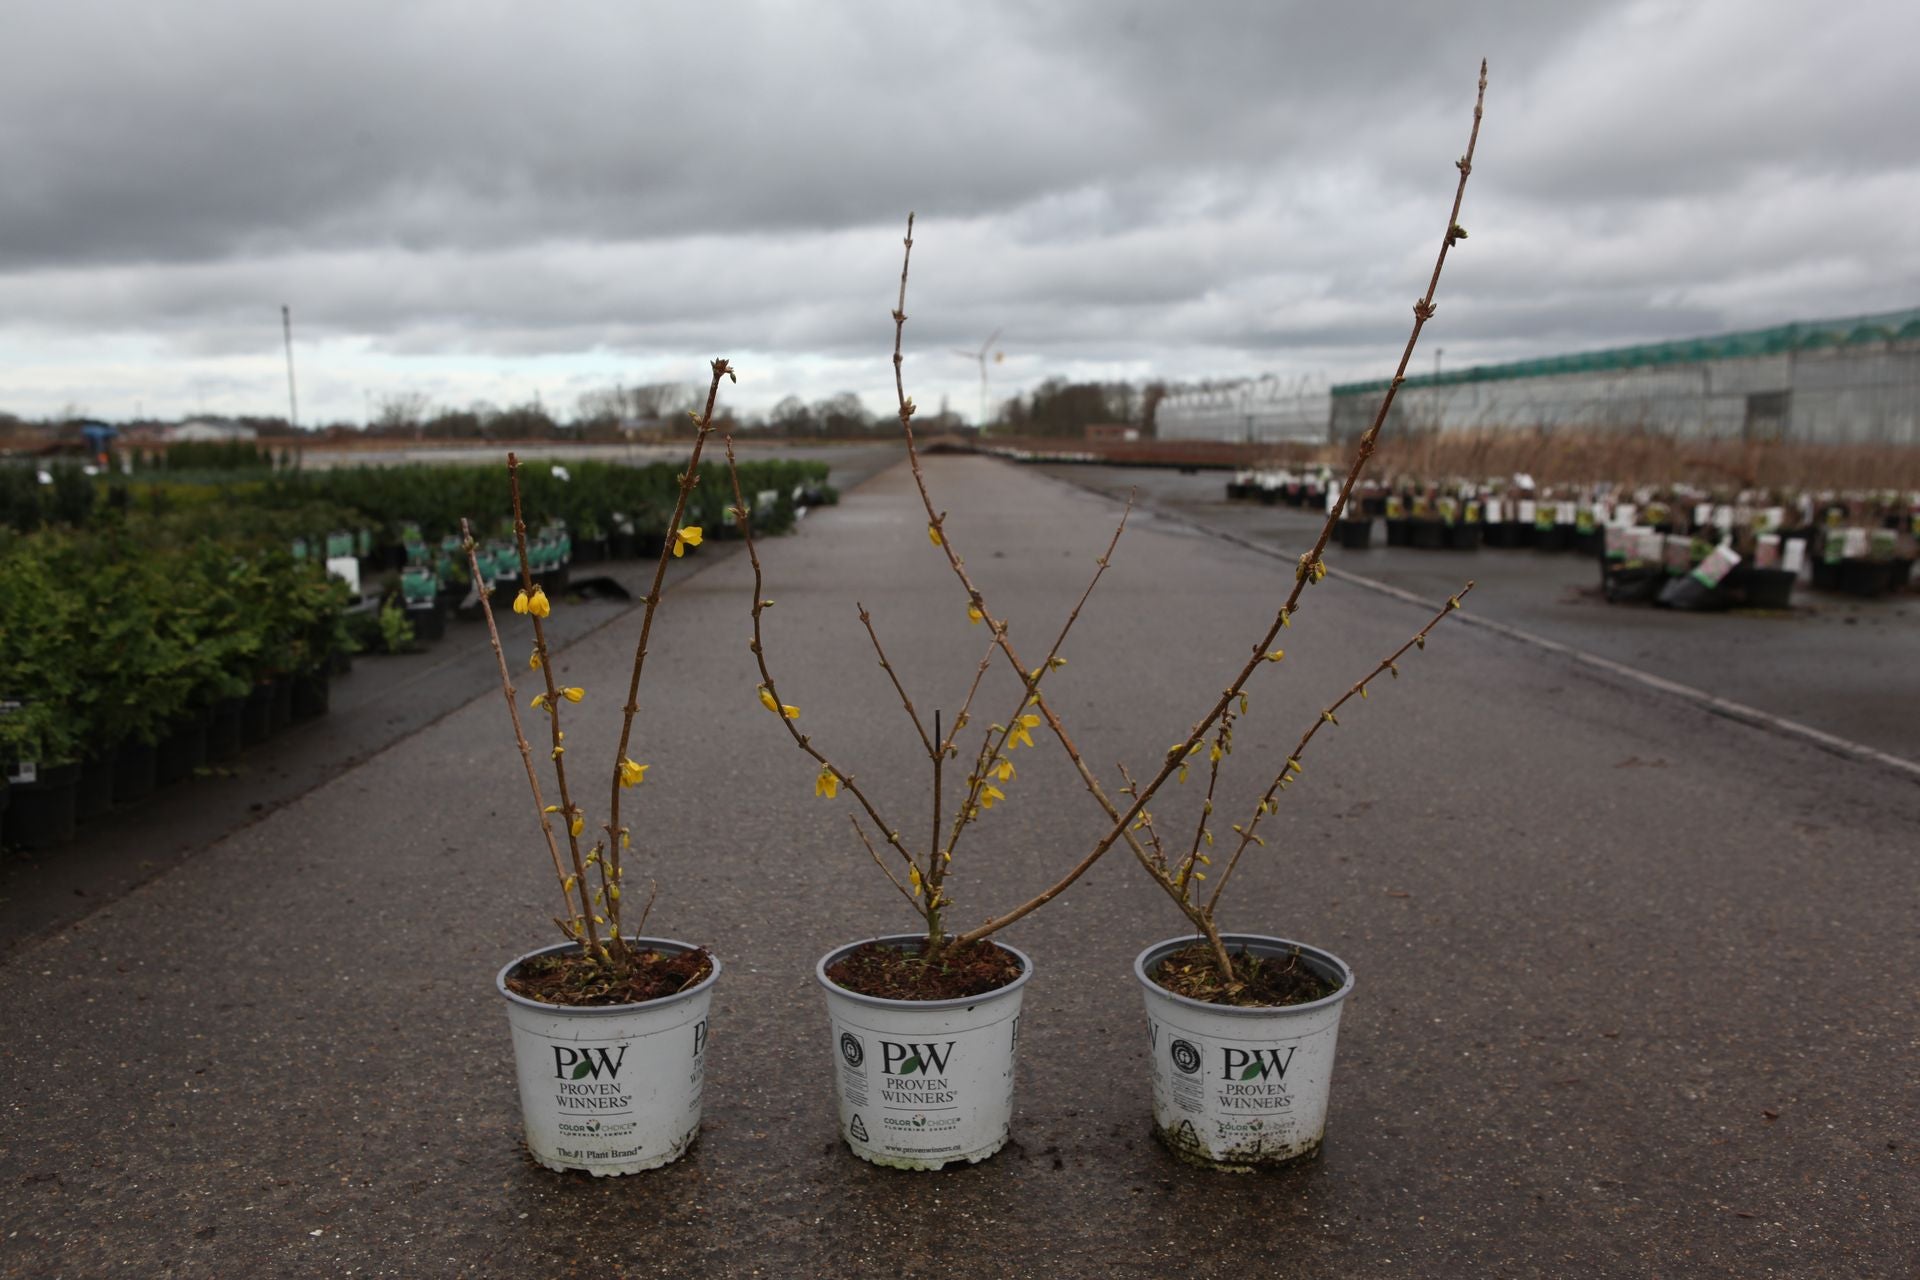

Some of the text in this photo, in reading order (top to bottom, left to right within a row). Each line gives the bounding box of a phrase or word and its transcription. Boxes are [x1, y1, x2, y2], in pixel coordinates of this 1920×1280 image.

[551, 1044, 630, 1081] PW
[879, 1040, 957, 1076] PW
[1220, 1046, 1298, 1081] PW
[559, 1082, 621, 1096] PROVEN
[886, 1077, 948, 1091] PROVEN
[1225, 1083, 1287, 1096] PROVEN
[558, 1122, 586, 1132] COLOR
[883, 1117, 911, 1127] COLOR
[557, 1146, 638, 1159] The #1 Plant Brand
